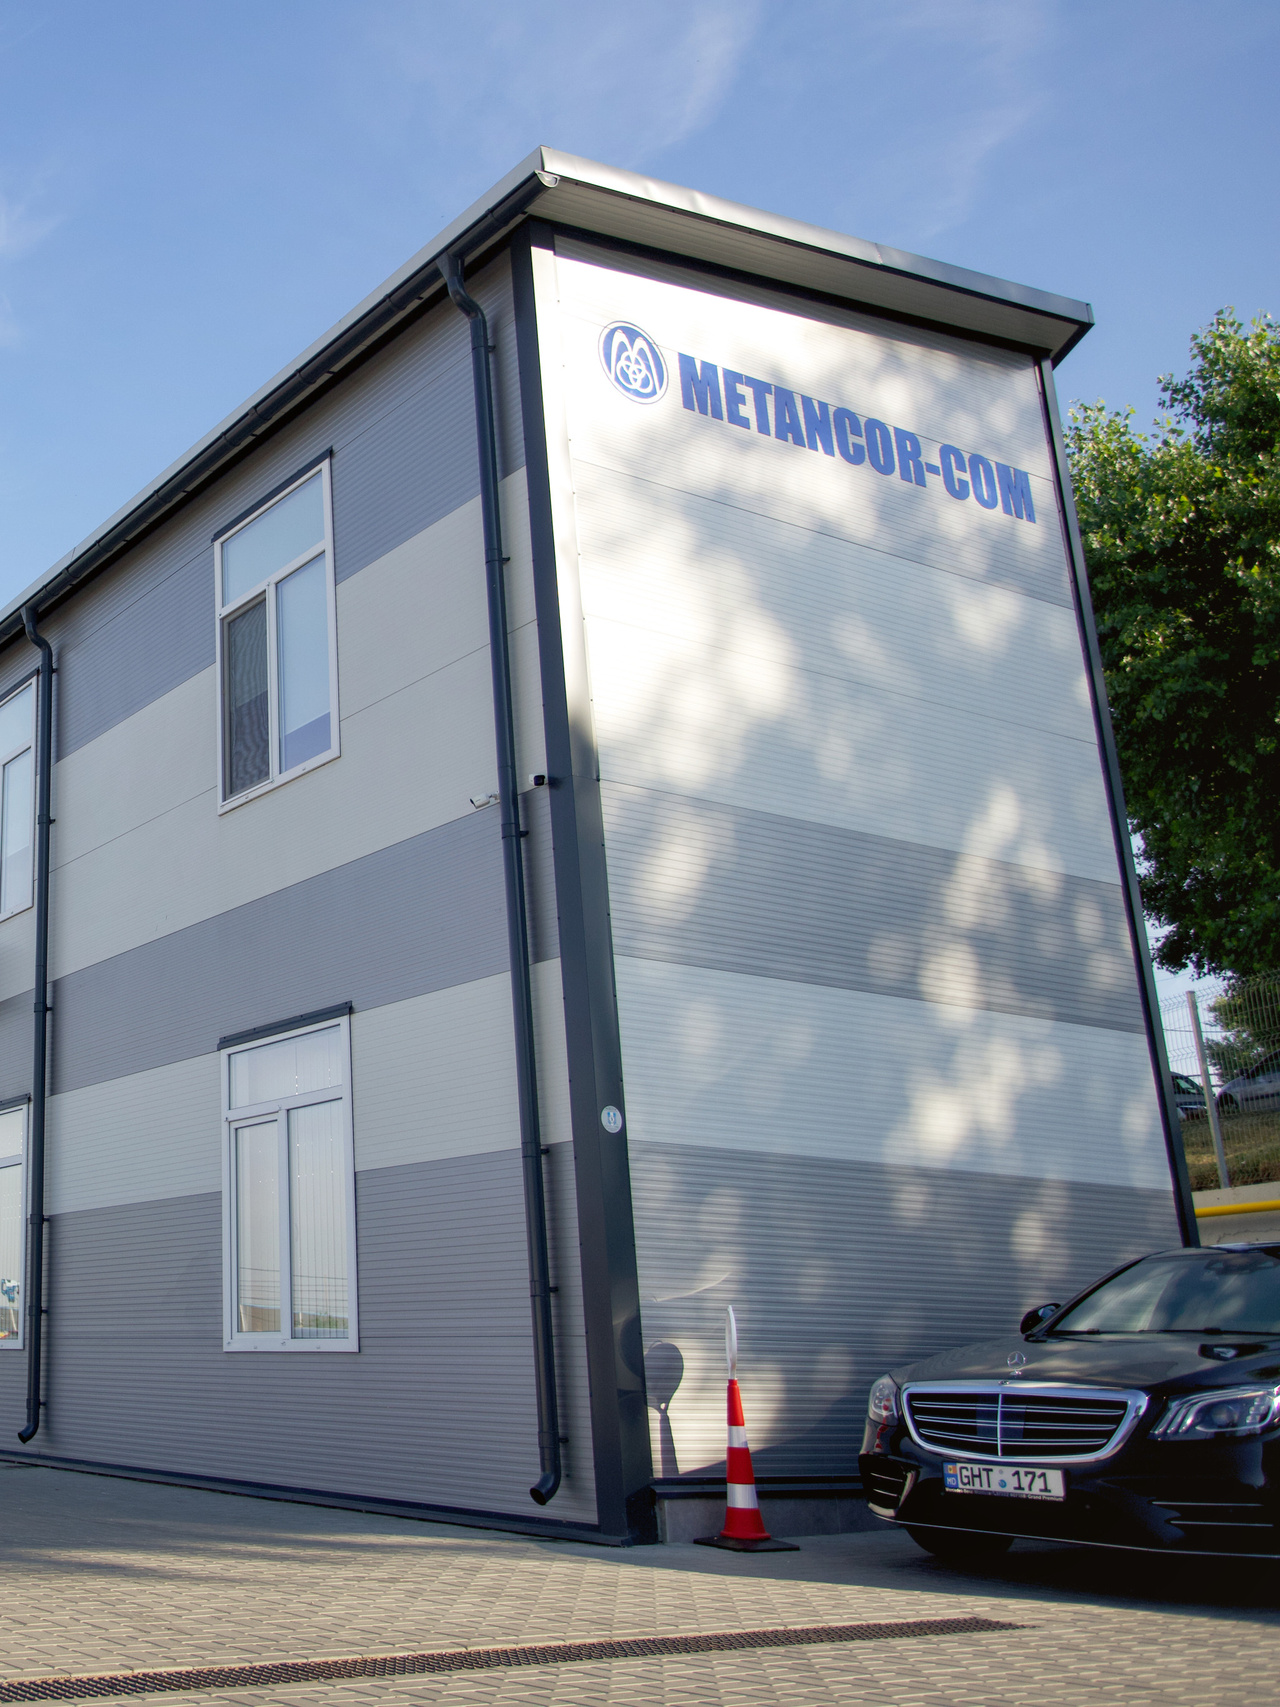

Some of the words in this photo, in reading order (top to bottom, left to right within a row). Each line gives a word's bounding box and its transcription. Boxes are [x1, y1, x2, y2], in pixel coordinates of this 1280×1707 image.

[677, 351, 1036, 524] METANCOR-COM
[946, 1477, 957, 1486] MD
[959, 1466, 994, 1488] GHT
[1011, 1470, 1052, 1493] 171
